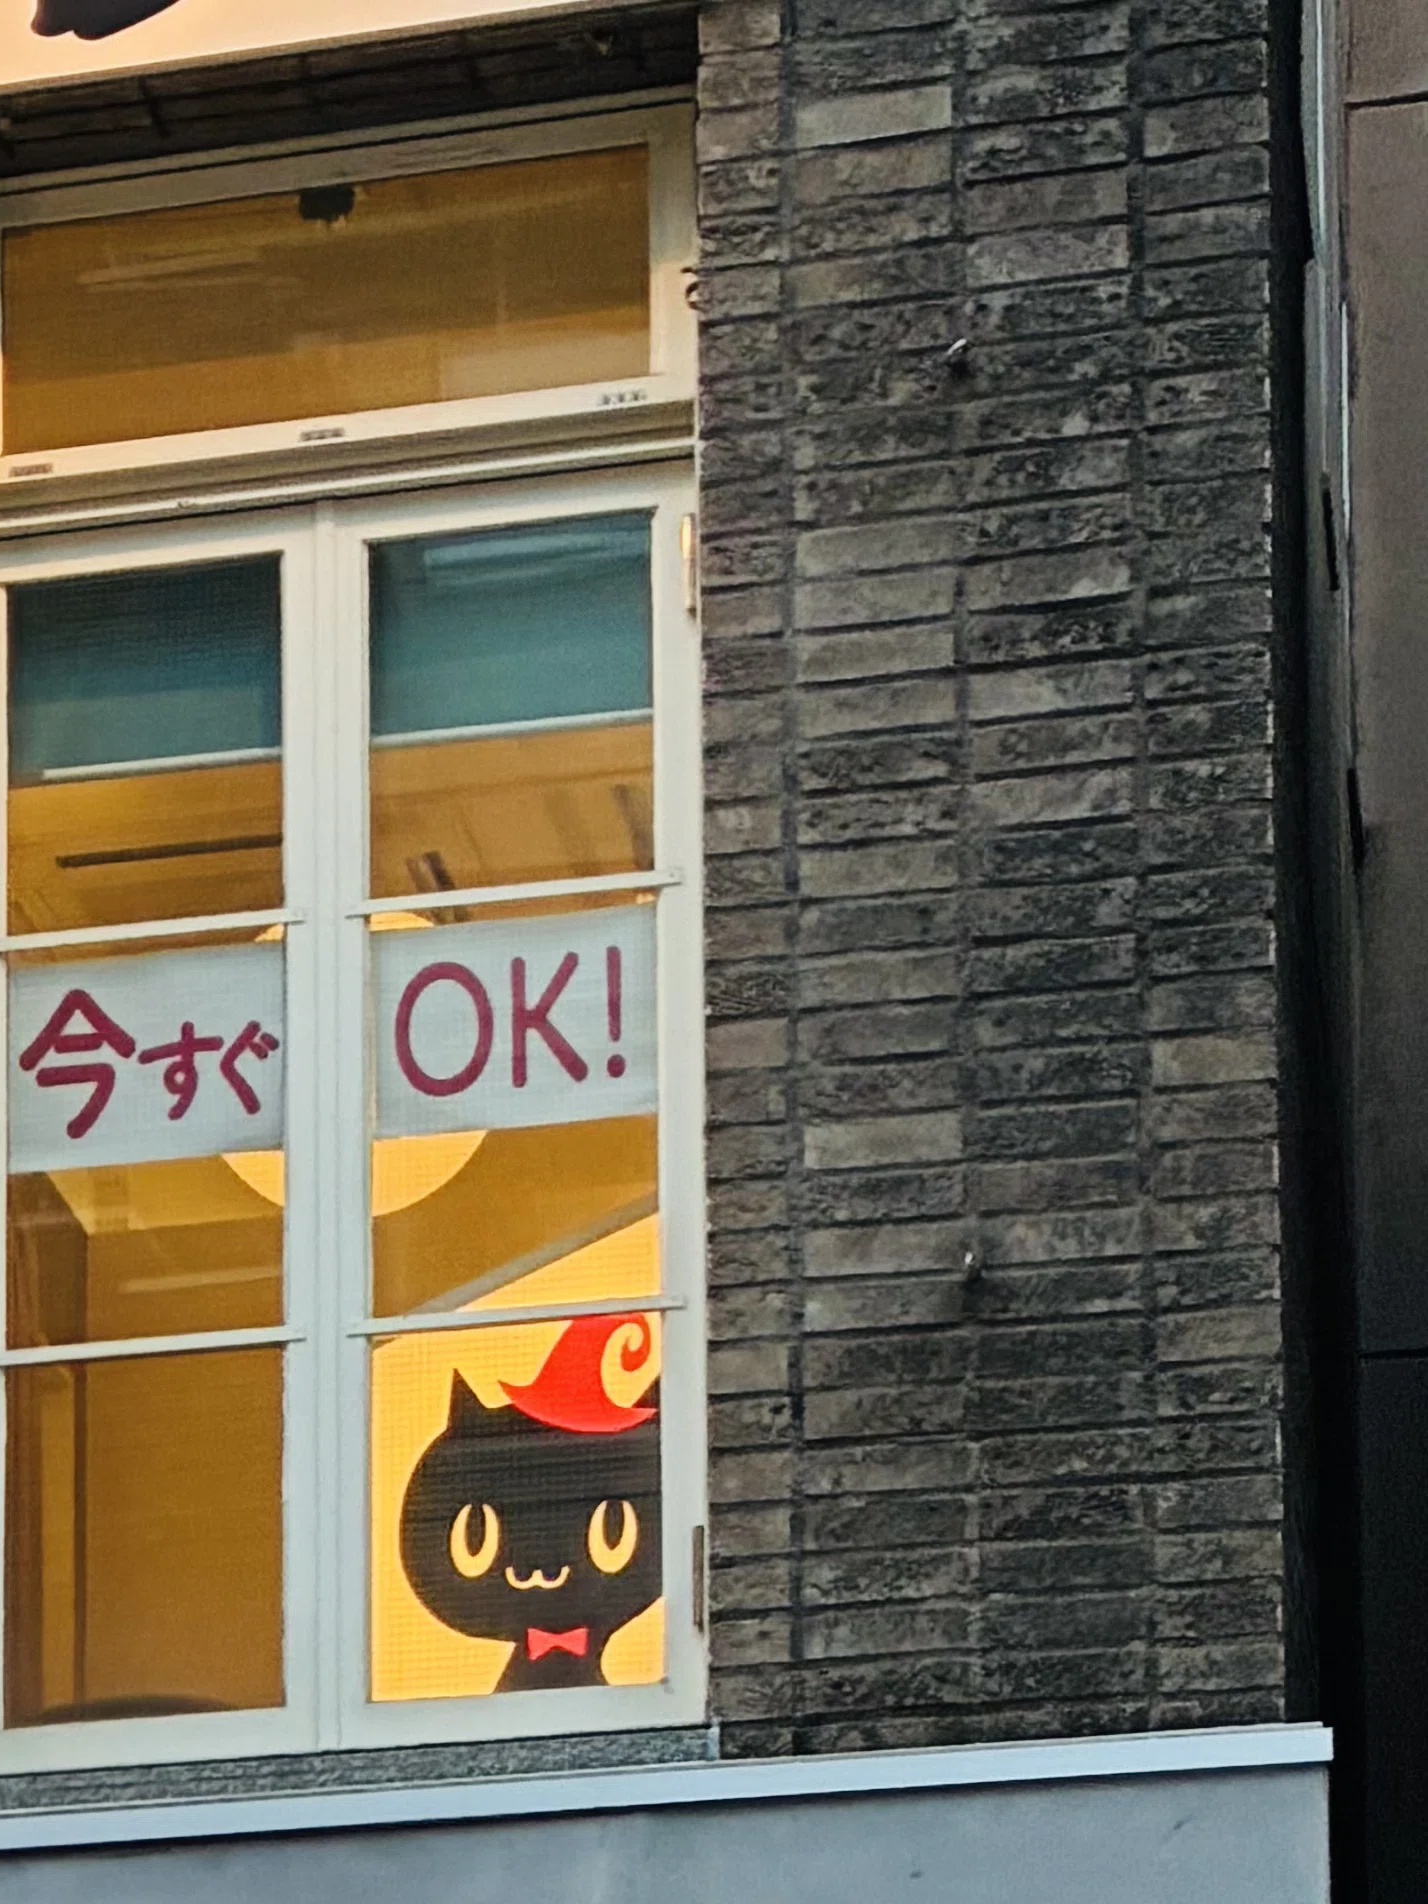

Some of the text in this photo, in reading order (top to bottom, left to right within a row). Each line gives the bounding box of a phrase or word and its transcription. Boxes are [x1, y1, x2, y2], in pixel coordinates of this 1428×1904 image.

[18, 988, 280, 1140] 今すぐ
[394, 944, 628, 1099] OK!
